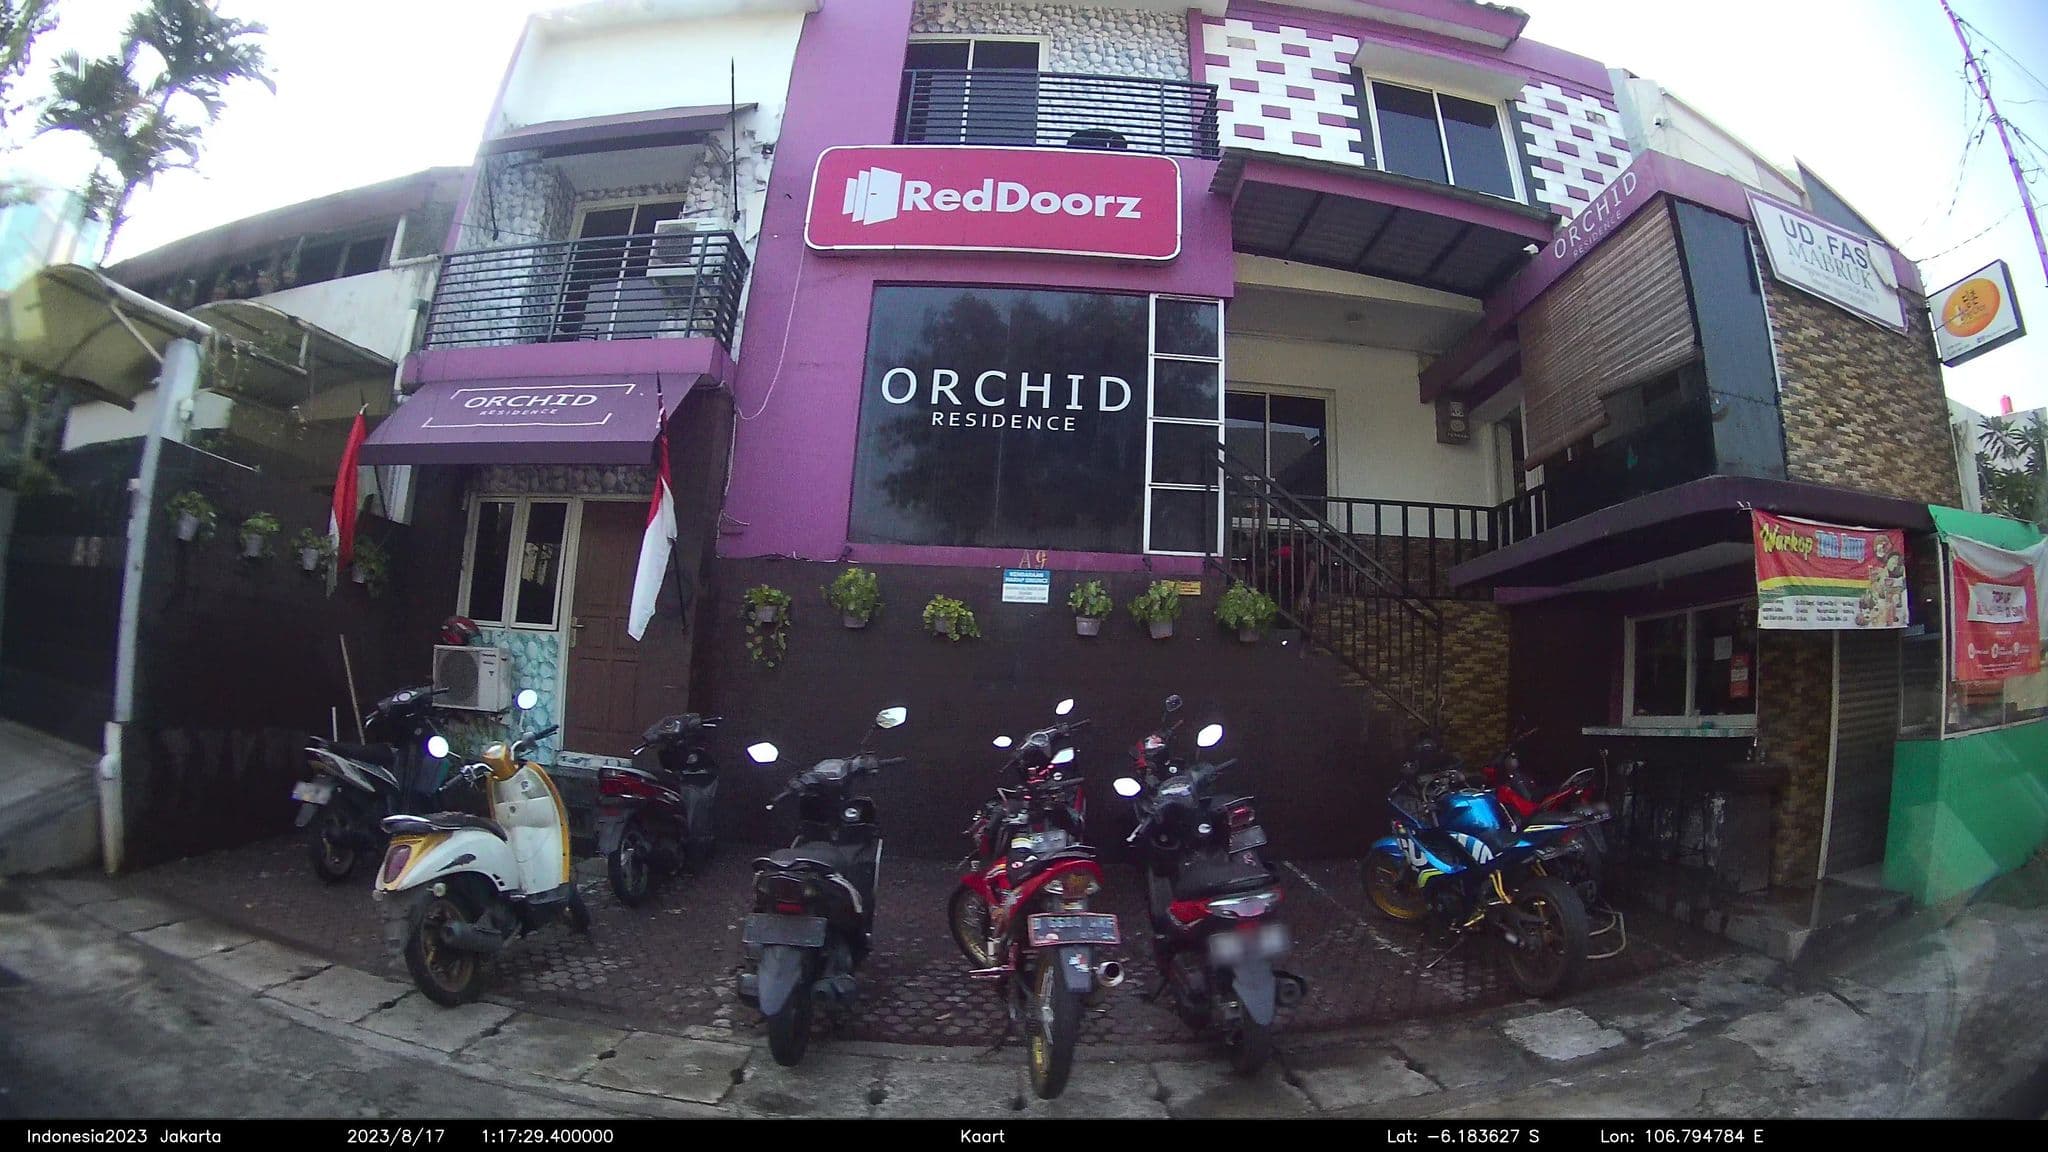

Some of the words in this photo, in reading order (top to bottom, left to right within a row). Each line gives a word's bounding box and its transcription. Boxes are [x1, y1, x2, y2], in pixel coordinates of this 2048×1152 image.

[901, 178, 1142, 220] RedDoorz
[1554, 171, 1637, 259] ORCHID
[1572, 209, 1622, 258] RESIDENCE
[1826, 235, 1869, 270] FAS
[1785, 237, 1876, 293] MABRUK
[464, 392, 598, 409] ORCHID
[881, 367, 1133, 414] ORCHID
[479, 408, 559, 417] RESIDENCE
[930, 411, 1077, 432] RESIDENCE
[1759, 522, 1813, 561] Warkop
